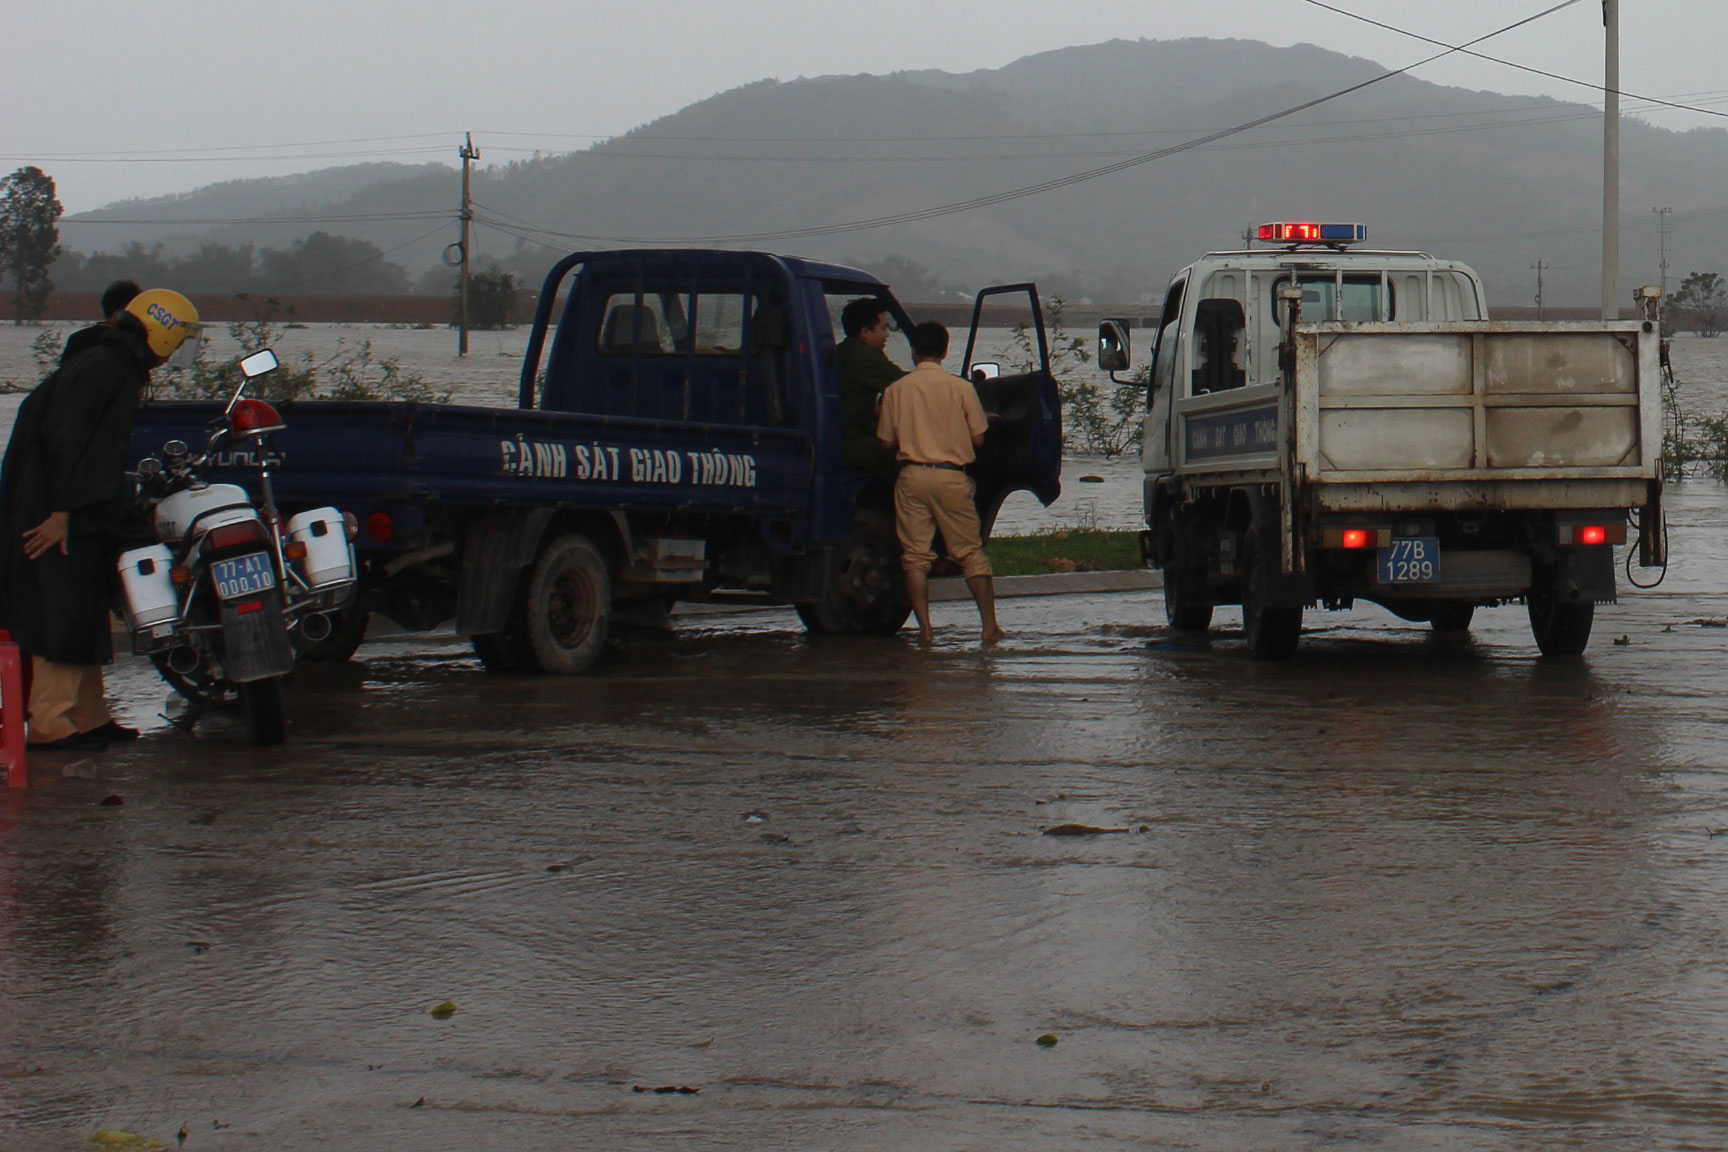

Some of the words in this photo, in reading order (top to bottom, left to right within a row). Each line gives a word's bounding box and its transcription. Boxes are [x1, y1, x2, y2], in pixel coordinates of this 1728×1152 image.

[147, 303, 179, 330] CSGT
[629, 447, 682, 484] GIAO
[687, 447, 757, 487] THÔNG
[1390, 540, 1425, 560] 77B
[219, 555, 262, 579] 77-A1
[1387, 560, 1433, 581] 1289
[219, 571, 272, 597] 000.10
